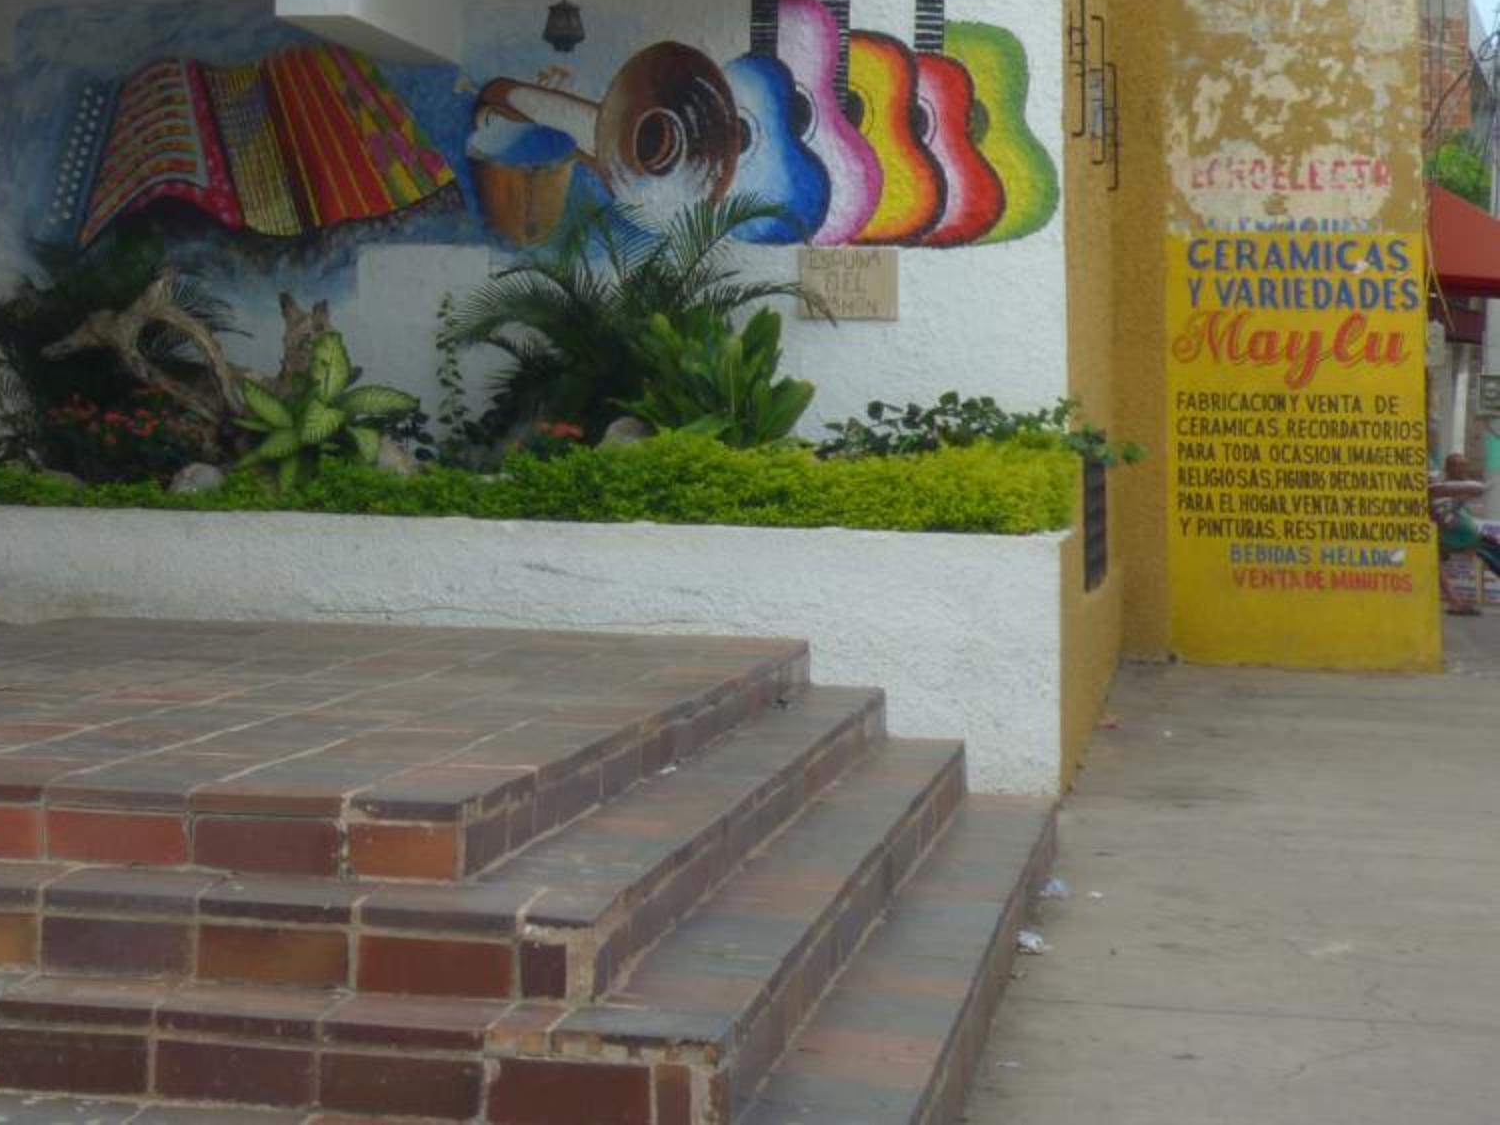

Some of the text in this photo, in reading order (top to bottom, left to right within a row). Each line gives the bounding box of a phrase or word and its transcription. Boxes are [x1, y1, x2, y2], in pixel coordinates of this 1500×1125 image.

[1187, 238, 1410, 272] CERAMICAS
[1187, 277, 1419, 310] Y VARIEDADES
[1176, 390, 1400, 414] FABRICACION Y VENTA DE
[1287, 418, 1424, 441] RECORDATORIOS
[1177, 441, 1216, 461] PARA
[1221, 442, 1261, 462] TODA
[1348, 446, 1426, 466] IMAGENES
[1329, 470, 1426, 492] DECORATIVAS
[1177, 491, 1214, 512] PARA
[1219, 492, 1235, 513] EL
[1291, 495, 1339, 515] VENTA
[1179, 517, 1192, 536] Y
[1284, 519, 1431, 543] RESTAURACIONES
[1230, 543, 1311, 564] BEBIDAS
[1232, 568, 1412, 594] VENTA DE MINUTOS
